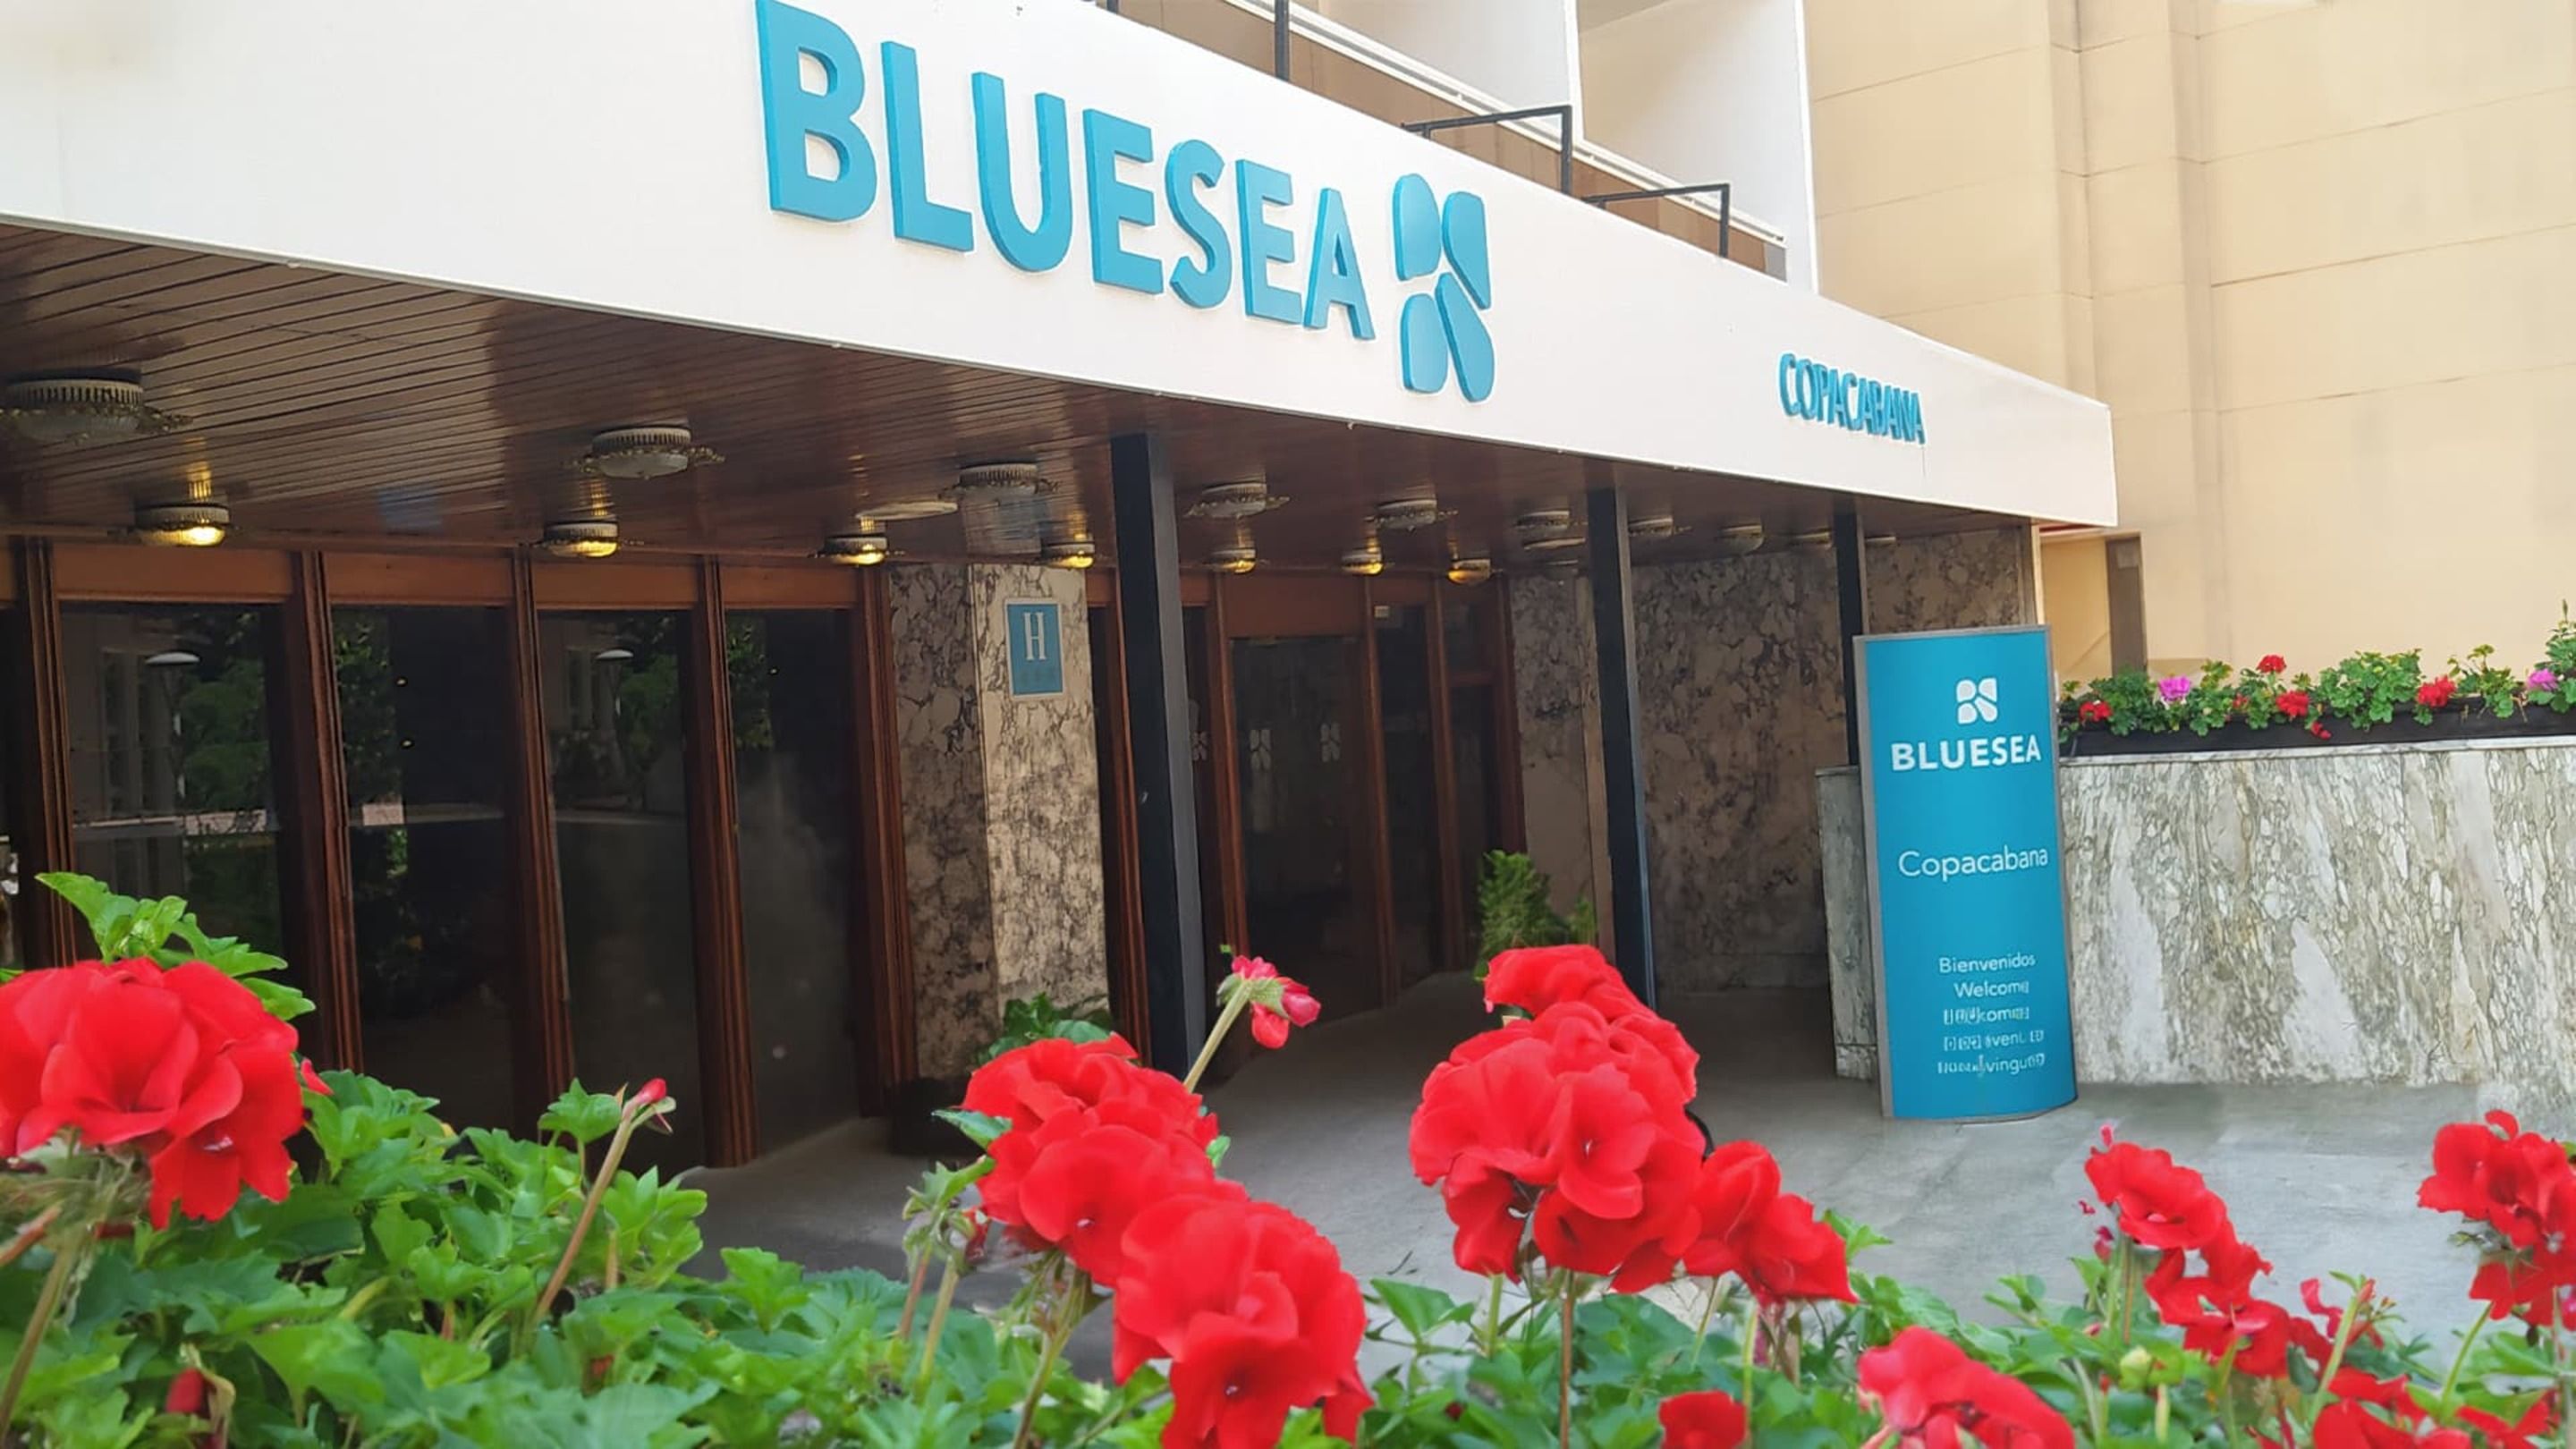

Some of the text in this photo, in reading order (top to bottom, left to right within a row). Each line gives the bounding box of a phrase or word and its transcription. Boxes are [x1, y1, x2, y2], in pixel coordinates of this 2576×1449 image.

[756, 0, 1376, 341] BLUESEA
[1779, 352, 1926, 445] COPACABANA
[1023, 612, 1046, 661] H
[1891, 734, 2042, 771] BLUESEA
[1898, 844, 2049, 882] Copacabana
[1938, 952, 2036, 974] Bienvenidos
